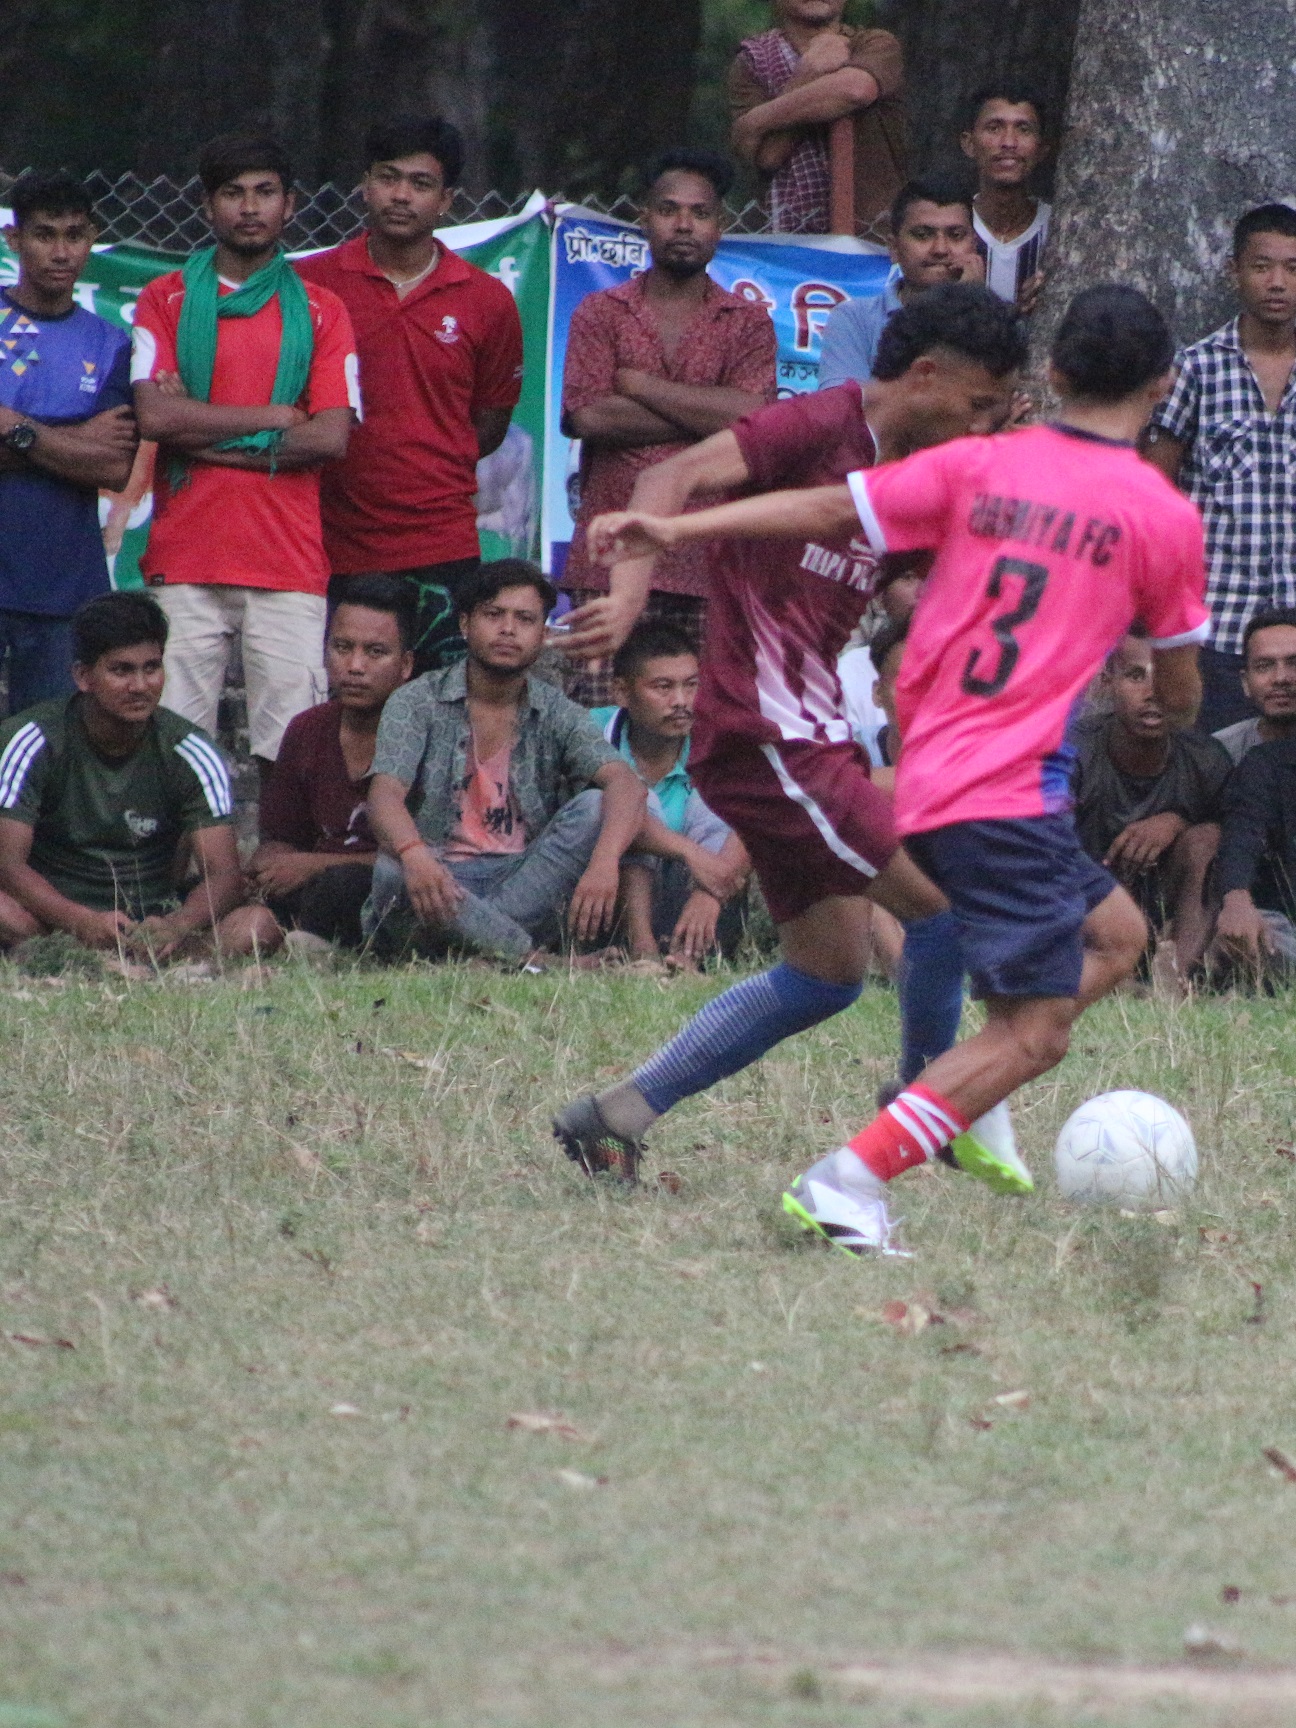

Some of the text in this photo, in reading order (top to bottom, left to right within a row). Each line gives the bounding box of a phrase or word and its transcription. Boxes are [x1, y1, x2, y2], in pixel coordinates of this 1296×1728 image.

[799, 542, 849, 583] THAPA
[1075, 518, 1123, 567] FC
[959, 555, 1050, 698] 3
